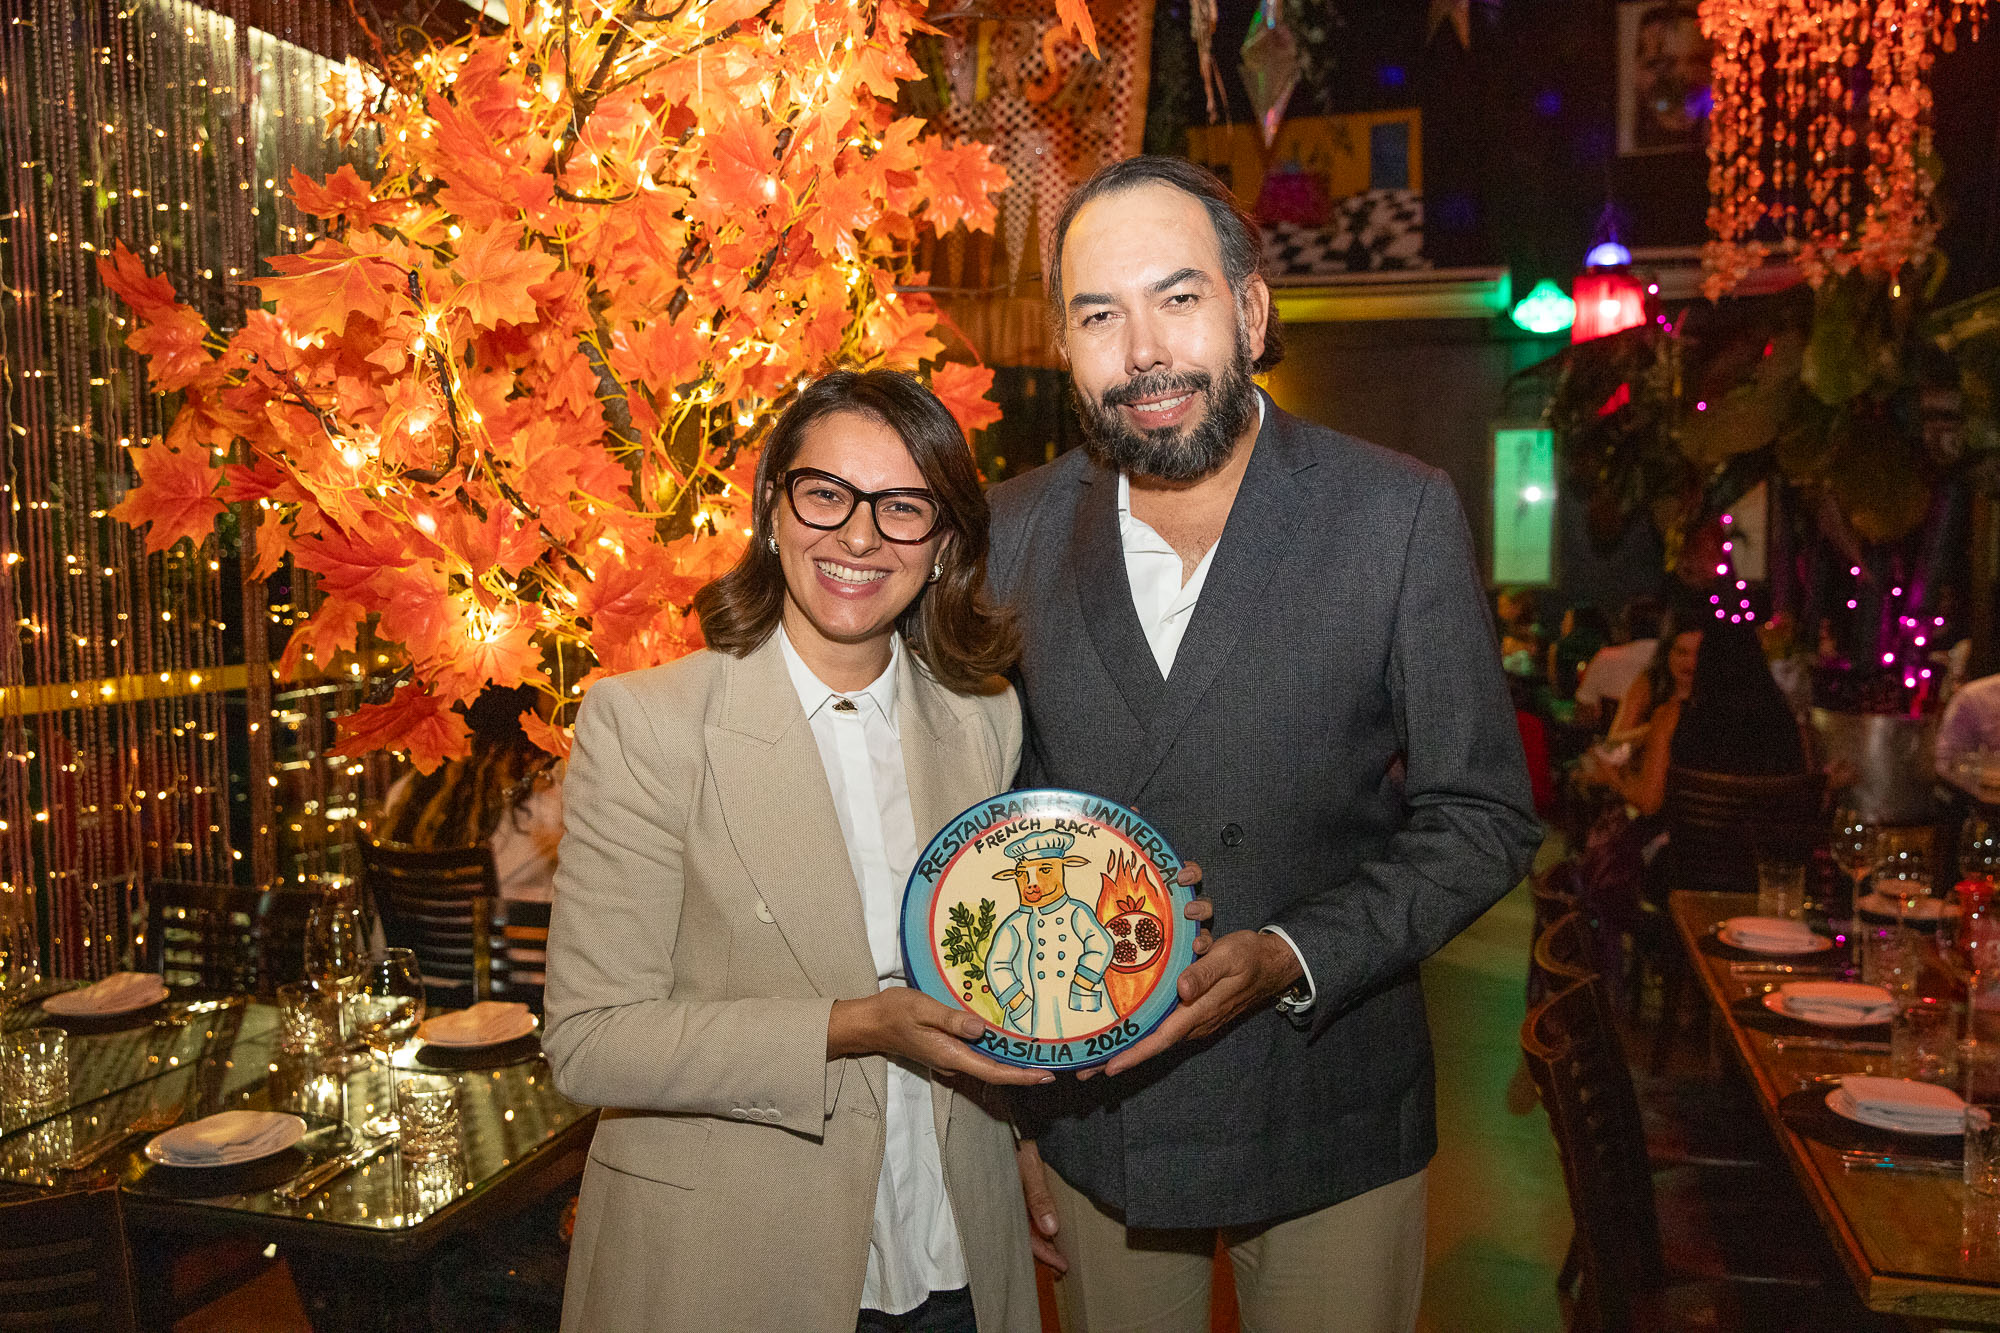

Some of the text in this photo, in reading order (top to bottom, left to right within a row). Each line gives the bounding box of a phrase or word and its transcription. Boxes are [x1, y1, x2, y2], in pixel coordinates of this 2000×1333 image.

[974, 817, 1100, 854] FRENCH RACK
[1081, 799, 1179, 897] UNIVERSAL
[976, 1018, 1140, 1062] RASÍLIA 2026
